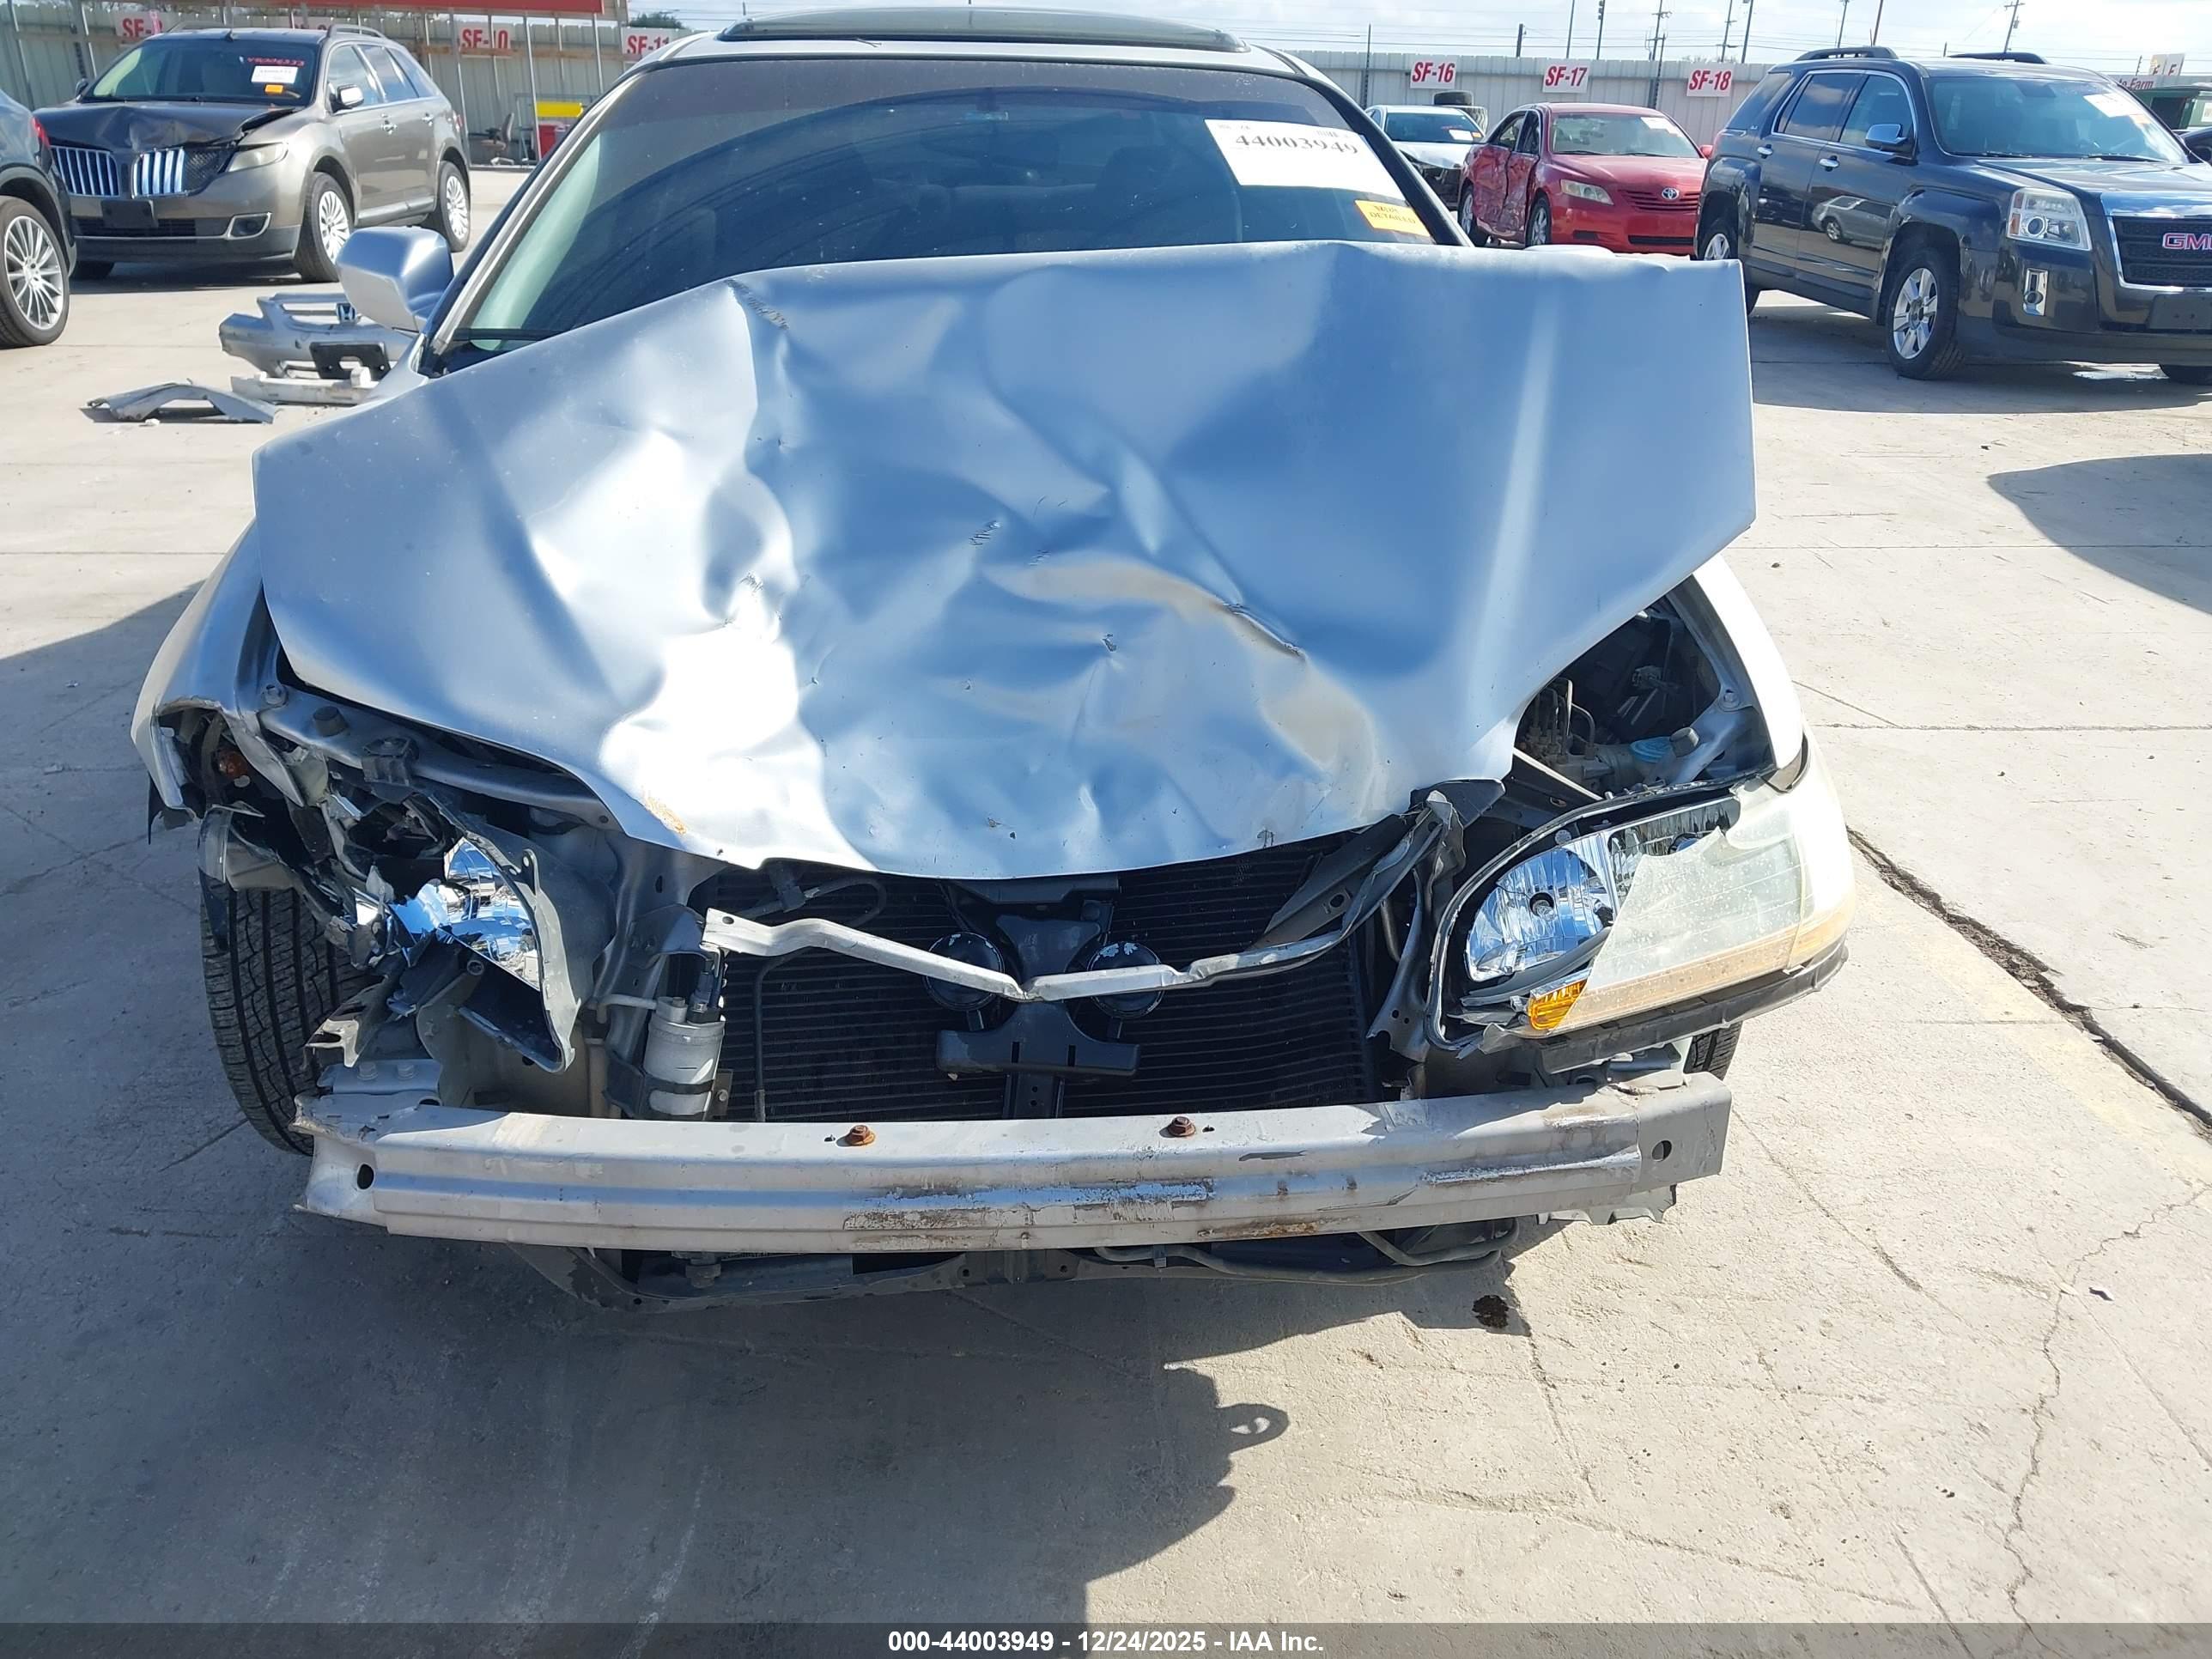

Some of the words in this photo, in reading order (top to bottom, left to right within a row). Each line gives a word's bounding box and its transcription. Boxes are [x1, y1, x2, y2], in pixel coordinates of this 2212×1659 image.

[123, 18, 162, 39] SF-
[1412, 61, 1455, 82] SF-16
[1545, 66, 1587, 87] SF-17
[1688, 70, 1732, 91] SF-18
[1236, 135, 1358, 154] 44003949
[2162, 233, 2212, 250] GM
